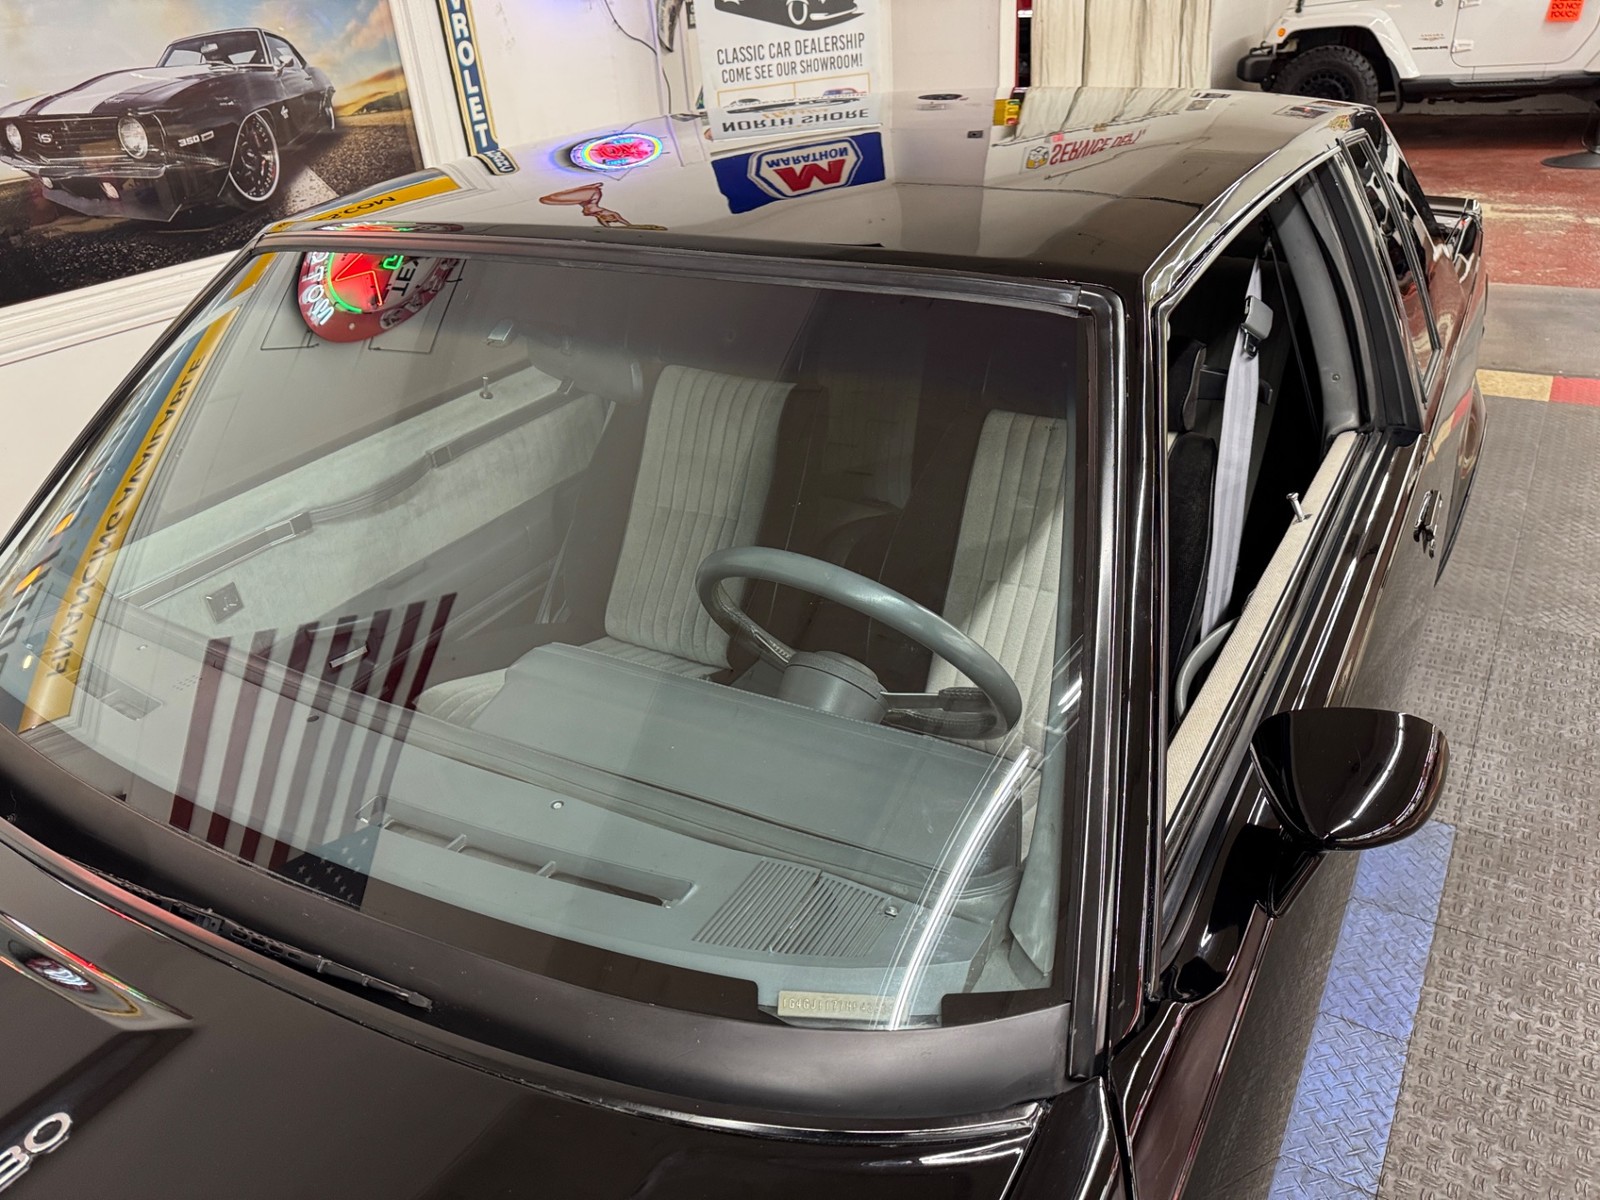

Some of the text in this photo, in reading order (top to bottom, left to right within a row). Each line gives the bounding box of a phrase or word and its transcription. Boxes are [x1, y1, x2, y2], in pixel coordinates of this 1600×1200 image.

[716, 32, 865, 65] CLASSIC CAR DEALERSHIP
[721, 53, 863, 83] COME SEE OUR SHOWROOM!
